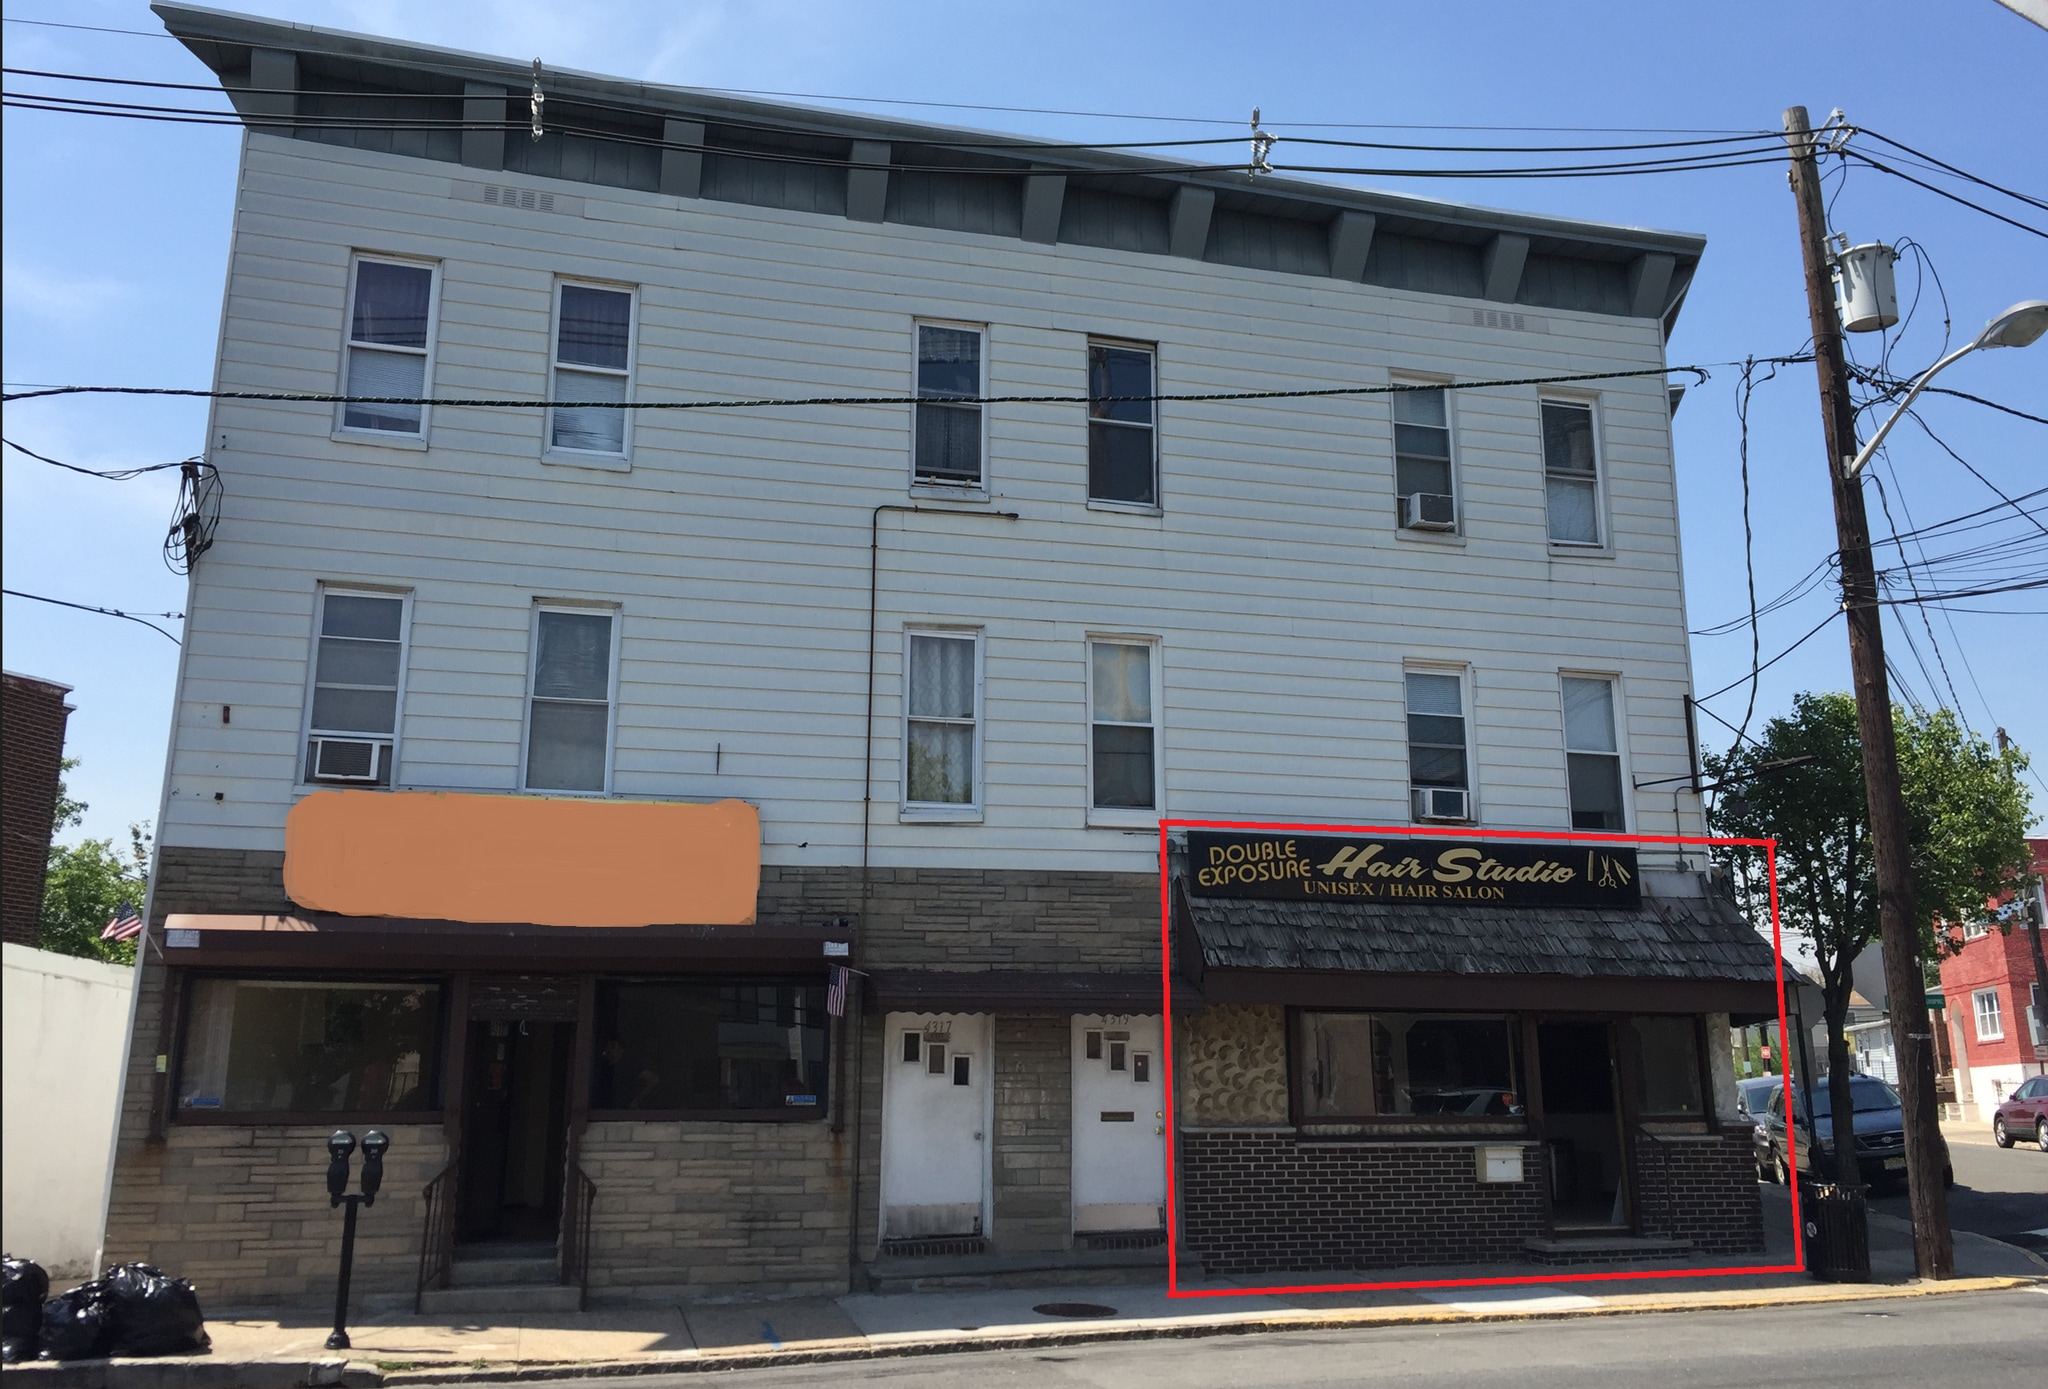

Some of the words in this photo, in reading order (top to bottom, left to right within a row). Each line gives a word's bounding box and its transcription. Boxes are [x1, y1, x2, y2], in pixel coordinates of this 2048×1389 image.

[1209, 840, 1297, 865] DOUBLE
[1316, 843, 1428, 879] Hair
[1432, 848, 1576, 883] Studio
[1198, 858, 1311, 886] EXPOSURE
[1304, 881, 1374, 896] UNISEX
[1390, 884, 1437, 898] HAIR
[1443, 885, 1504, 899] SALON
[924, 1020, 952, 1033] 4317
